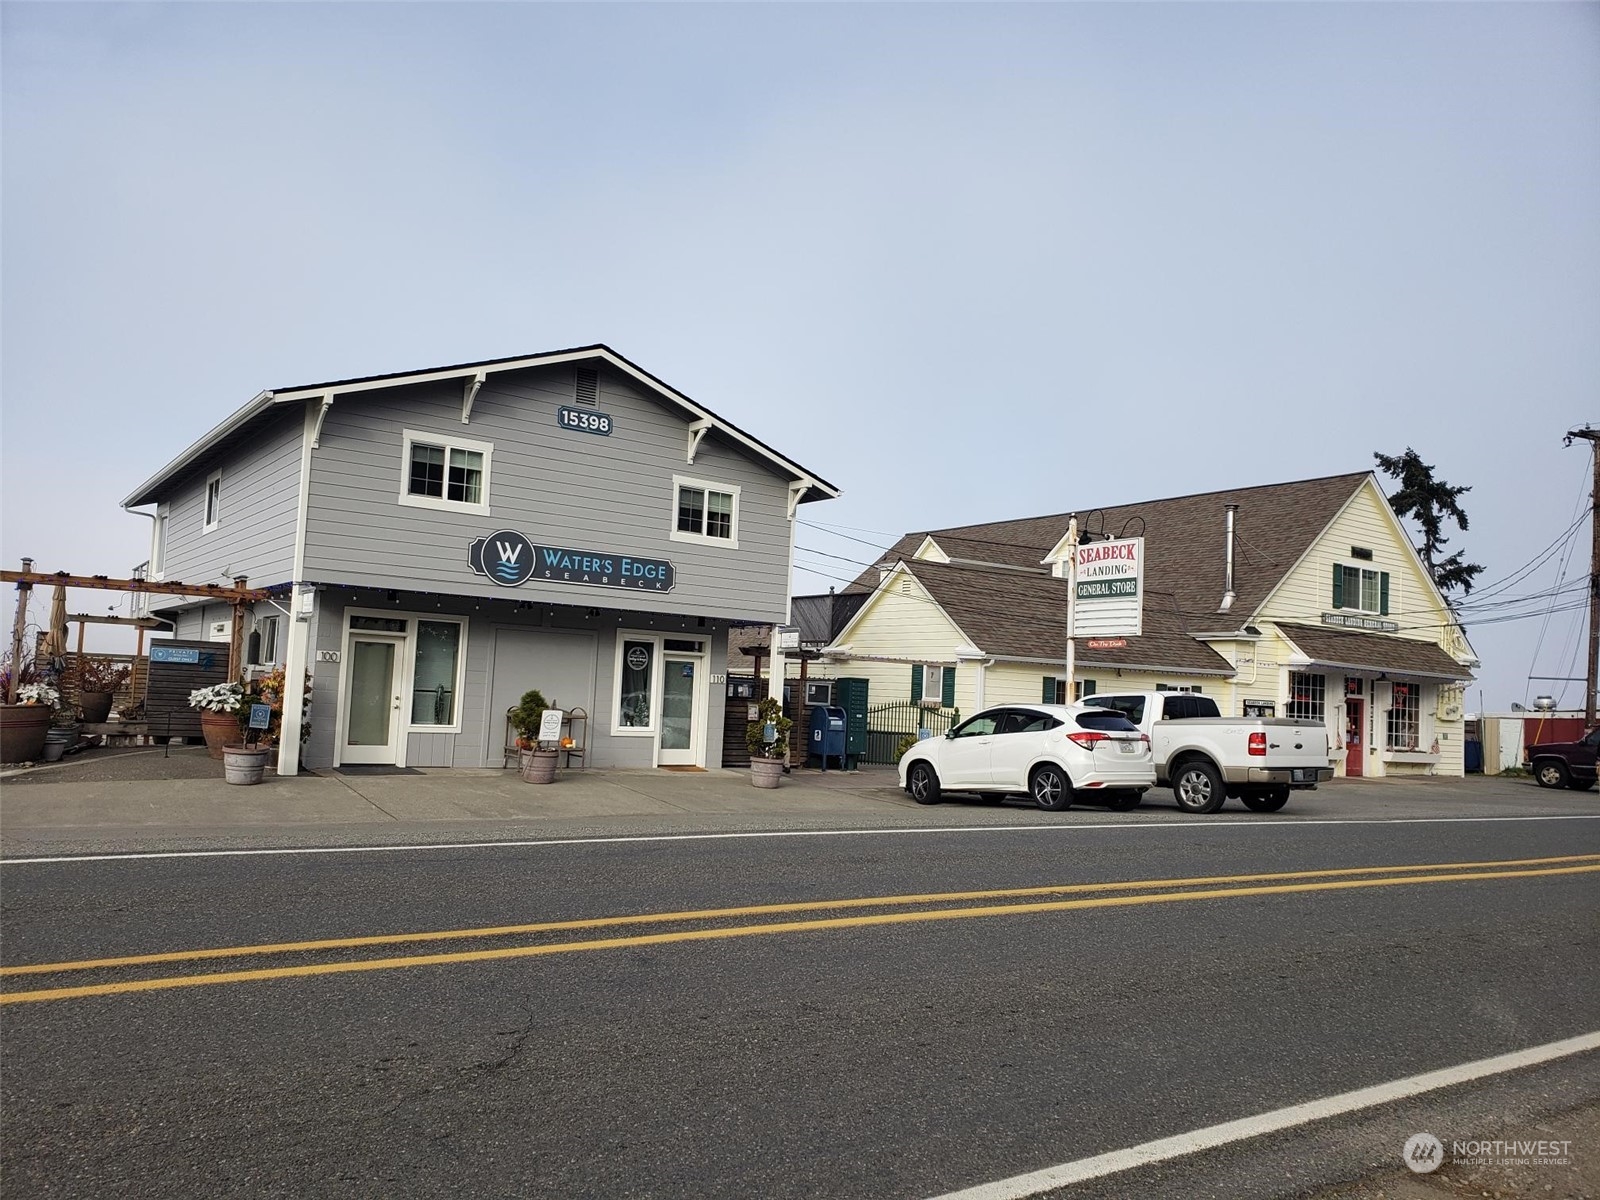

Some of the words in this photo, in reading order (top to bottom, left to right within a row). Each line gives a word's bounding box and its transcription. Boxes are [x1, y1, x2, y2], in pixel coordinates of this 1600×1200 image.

[562, 410, 609, 431] 15398
[496, 540, 523, 565] W
[1079, 543, 1136, 565] SEABECK
[543, 549, 613, 574] WATER'S
[621, 558, 666, 580] EDGE
[1086, 564, 1128, 577] LANDING
[545, 570, 662, 589] SEABECK
[1078, 582, 1110, 596] GENERAL
[1111, 581, 1136, 594] STORE
[321, 652, 337, 662] 100
[713, 675, 724, 684] 110
